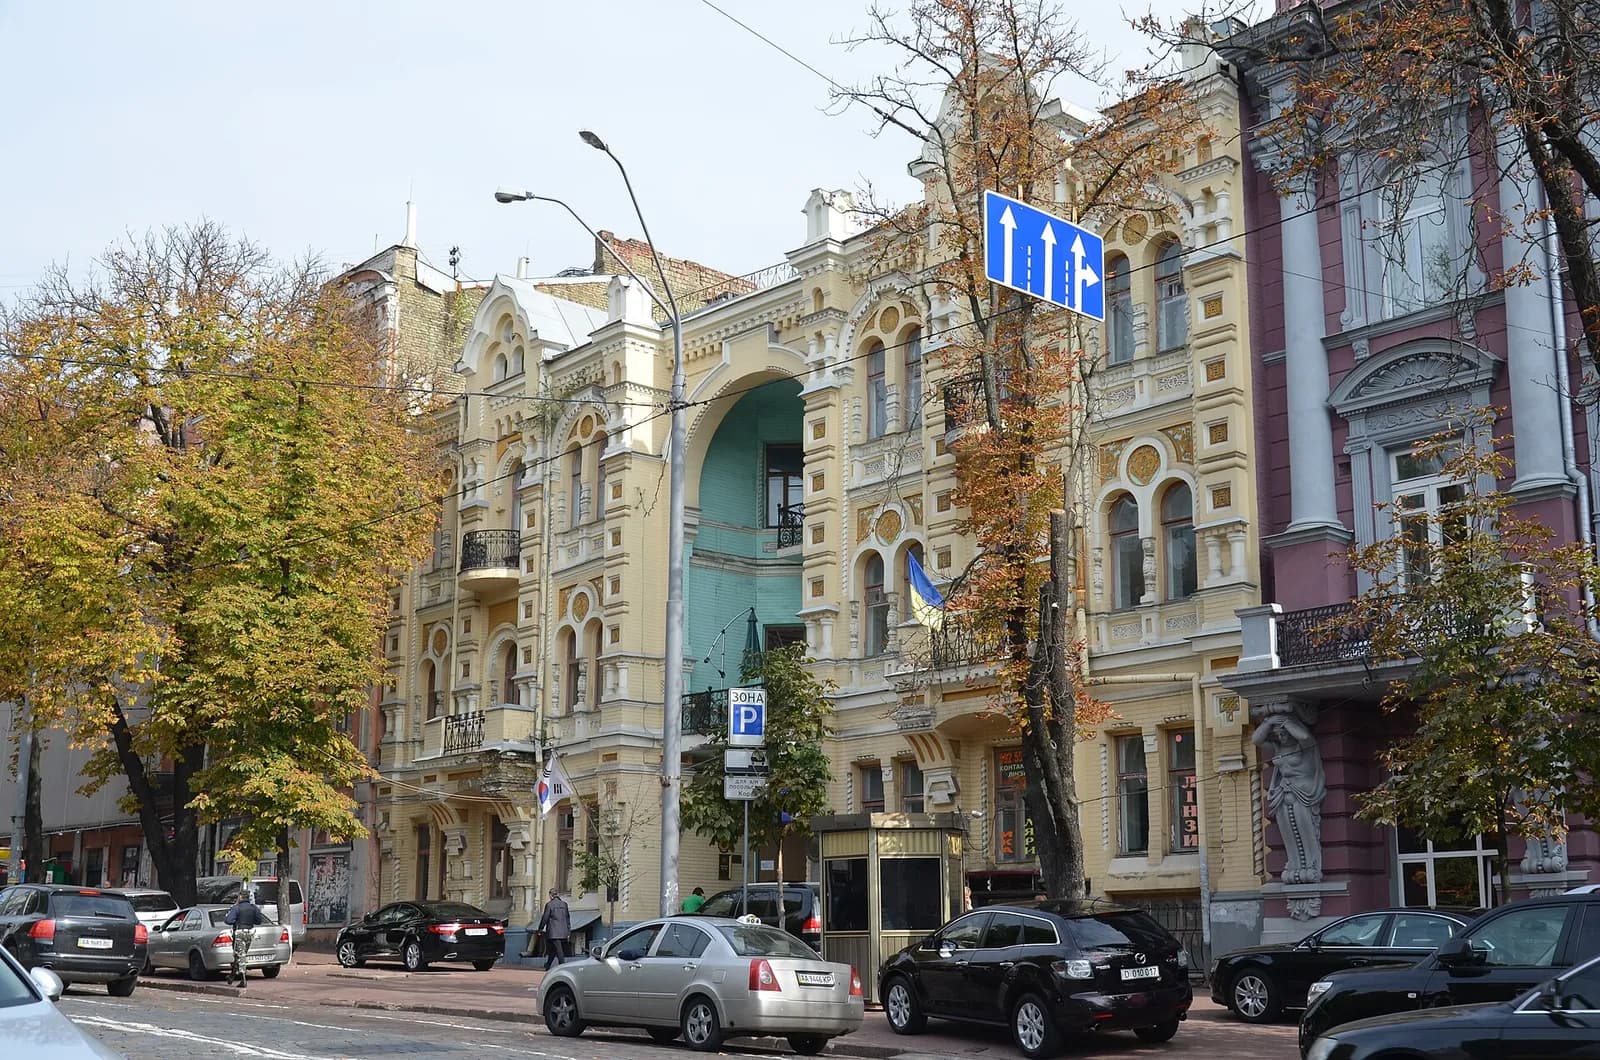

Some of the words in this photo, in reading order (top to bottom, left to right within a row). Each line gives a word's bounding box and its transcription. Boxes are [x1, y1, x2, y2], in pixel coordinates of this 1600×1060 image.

[732, 692, 764, 704] ЗОНА
[740, 706, 758, 733] P
[1000, 763, 1025, 772] КОНТАК
